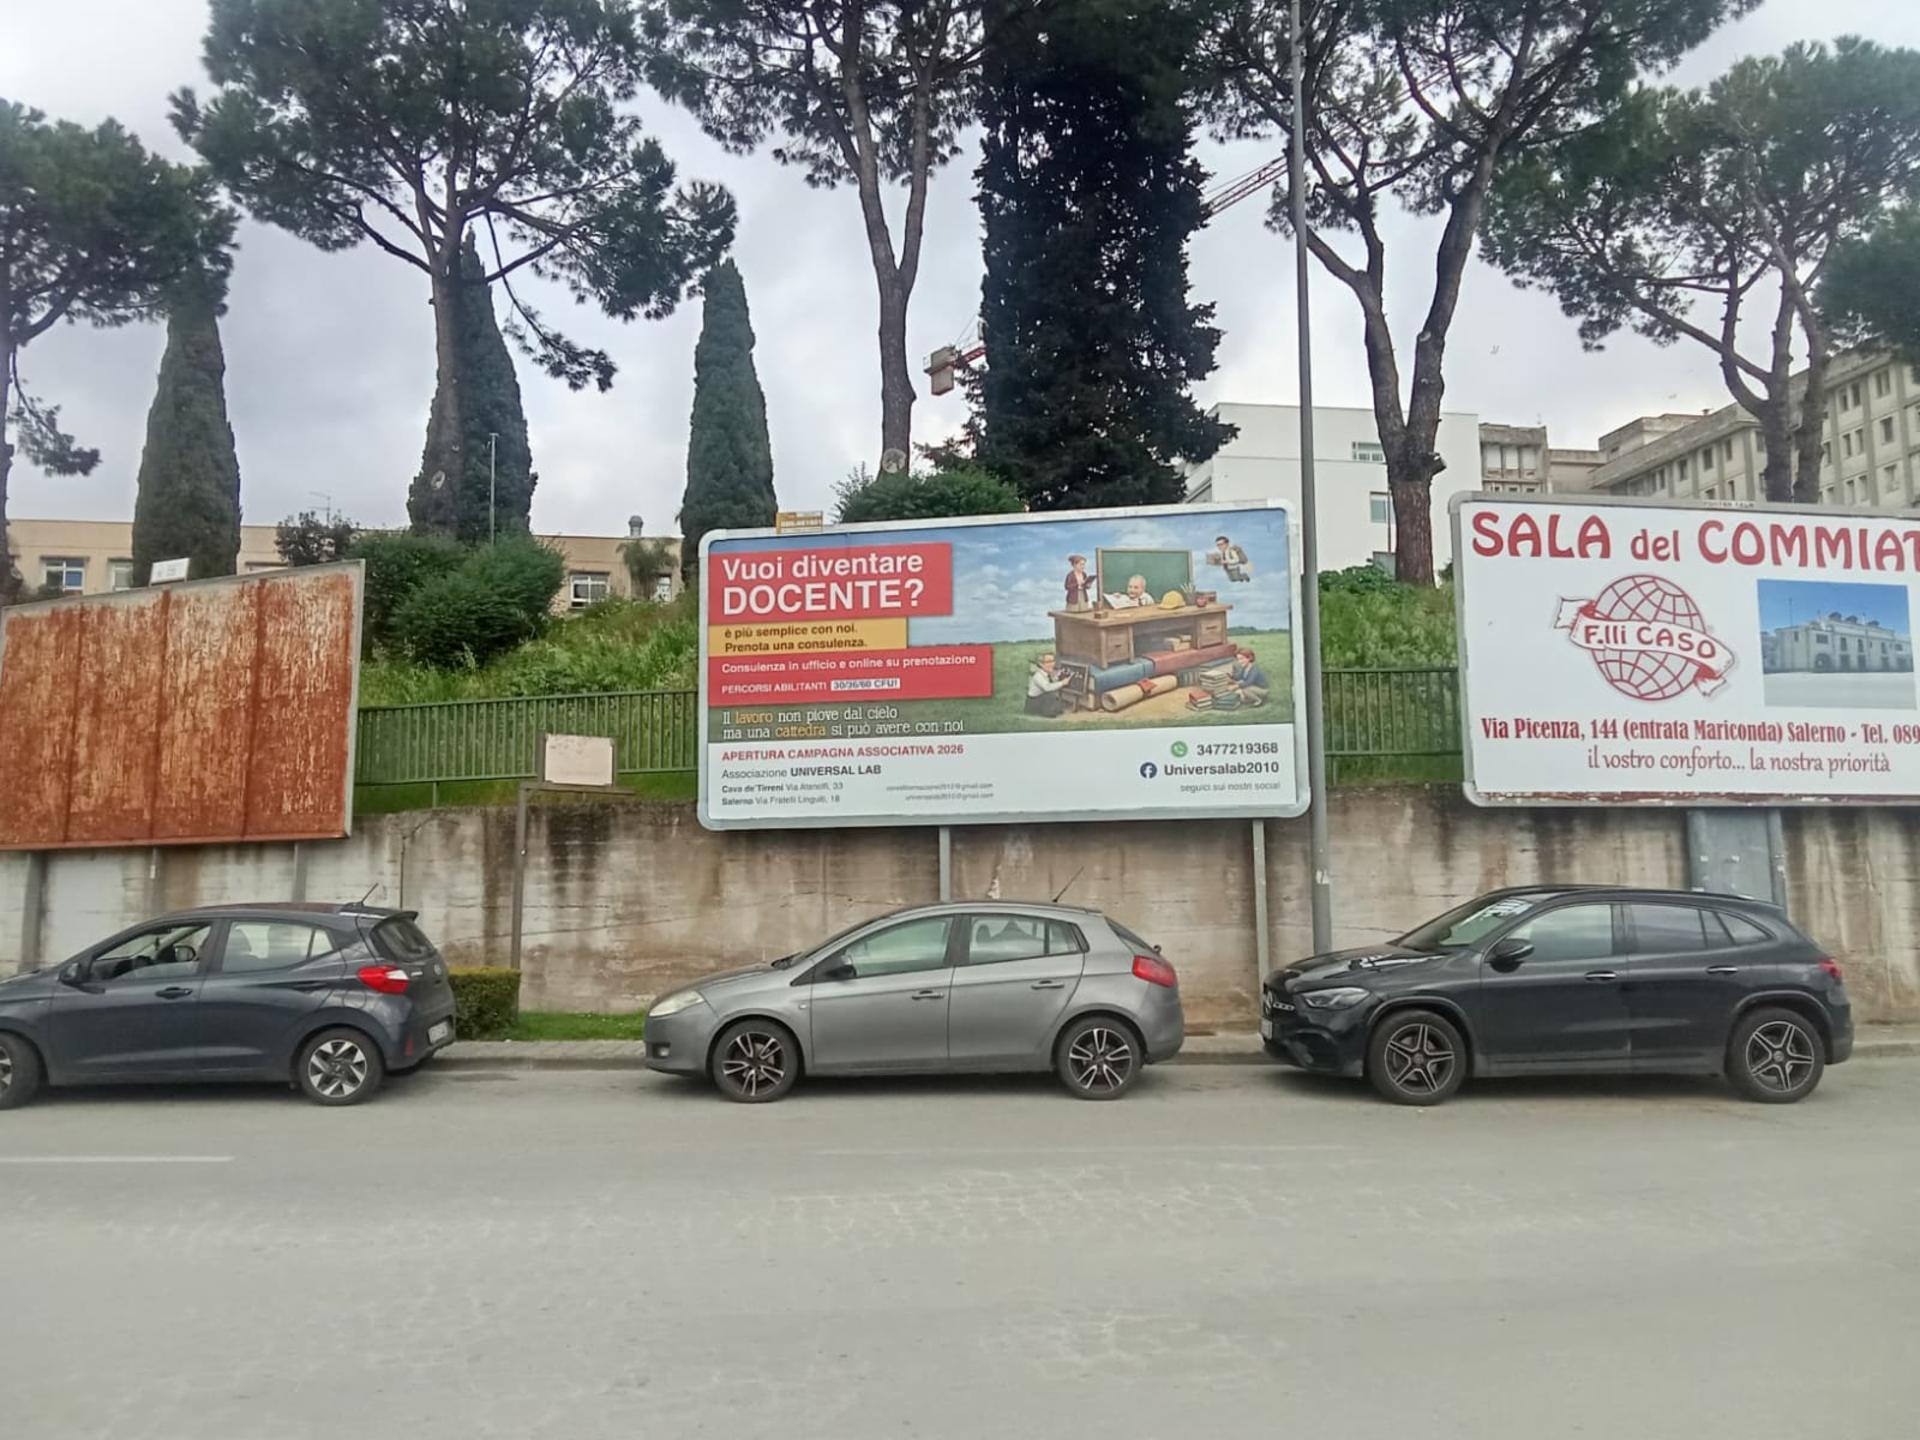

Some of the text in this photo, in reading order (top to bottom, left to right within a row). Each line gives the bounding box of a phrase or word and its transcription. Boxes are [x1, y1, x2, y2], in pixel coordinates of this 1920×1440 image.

[1472, 511, 1920, 571] SALA del COMMIAT
[723, 553, 923, 580] Vuoi diventare
[724, 579, 924, 615] DOCENTE?
[725, 629, 731, 638] è
[735, 627, 752, 640] più
[756, 626, 808, 640] semplice
[811, 626, 832, 635] con
[1637, 625, 1717, 658] CASO
[725, 638, 867, 652] Prenota una consulenza.
[722, 662, 785, 673] Consulenza
[789, 660, 799, 670] in
[802, 659, 836, 670] ufficio
[849, 658, 883, 668] online
[886, 659, 900, 667] su
[902, 655, 976, 669] prenotazione
[722, 684, 772, 694] PERCORSI
[774, 682, 826, 692] ABILITANTI
[723, 705, 897, 724] Il lavoro non piove dal cielo
[723, 720, 963, 739] ma una cattedra si può avere con noi
[1481, 718, 1507, 739] Via
[1514, 718, 1585, 740] Picenza,
[1591, 720, 1618, 739] 144
[1624, 721, 1688, 741] (entrata
[1694, 720, 1783, 743] Mariconda)
[1788, 722, 1846, 742] Salerno
[1862, 723, 1888, 744] Tel.
[722, 744, 964, 762] APERTURA CAMPAGNA ASSOCIATIVA 2026
[1197, 742, 1278, 756] 3477219368
[722, 764, 881, 779] Associazione UNIVERSAL LAB
[1165, 762, 1279, 776] Universalab2010
[1588, 747, 1891, 778] il vostro conforto... la nostra priorità
[722, 785, 742, 793] Cava
